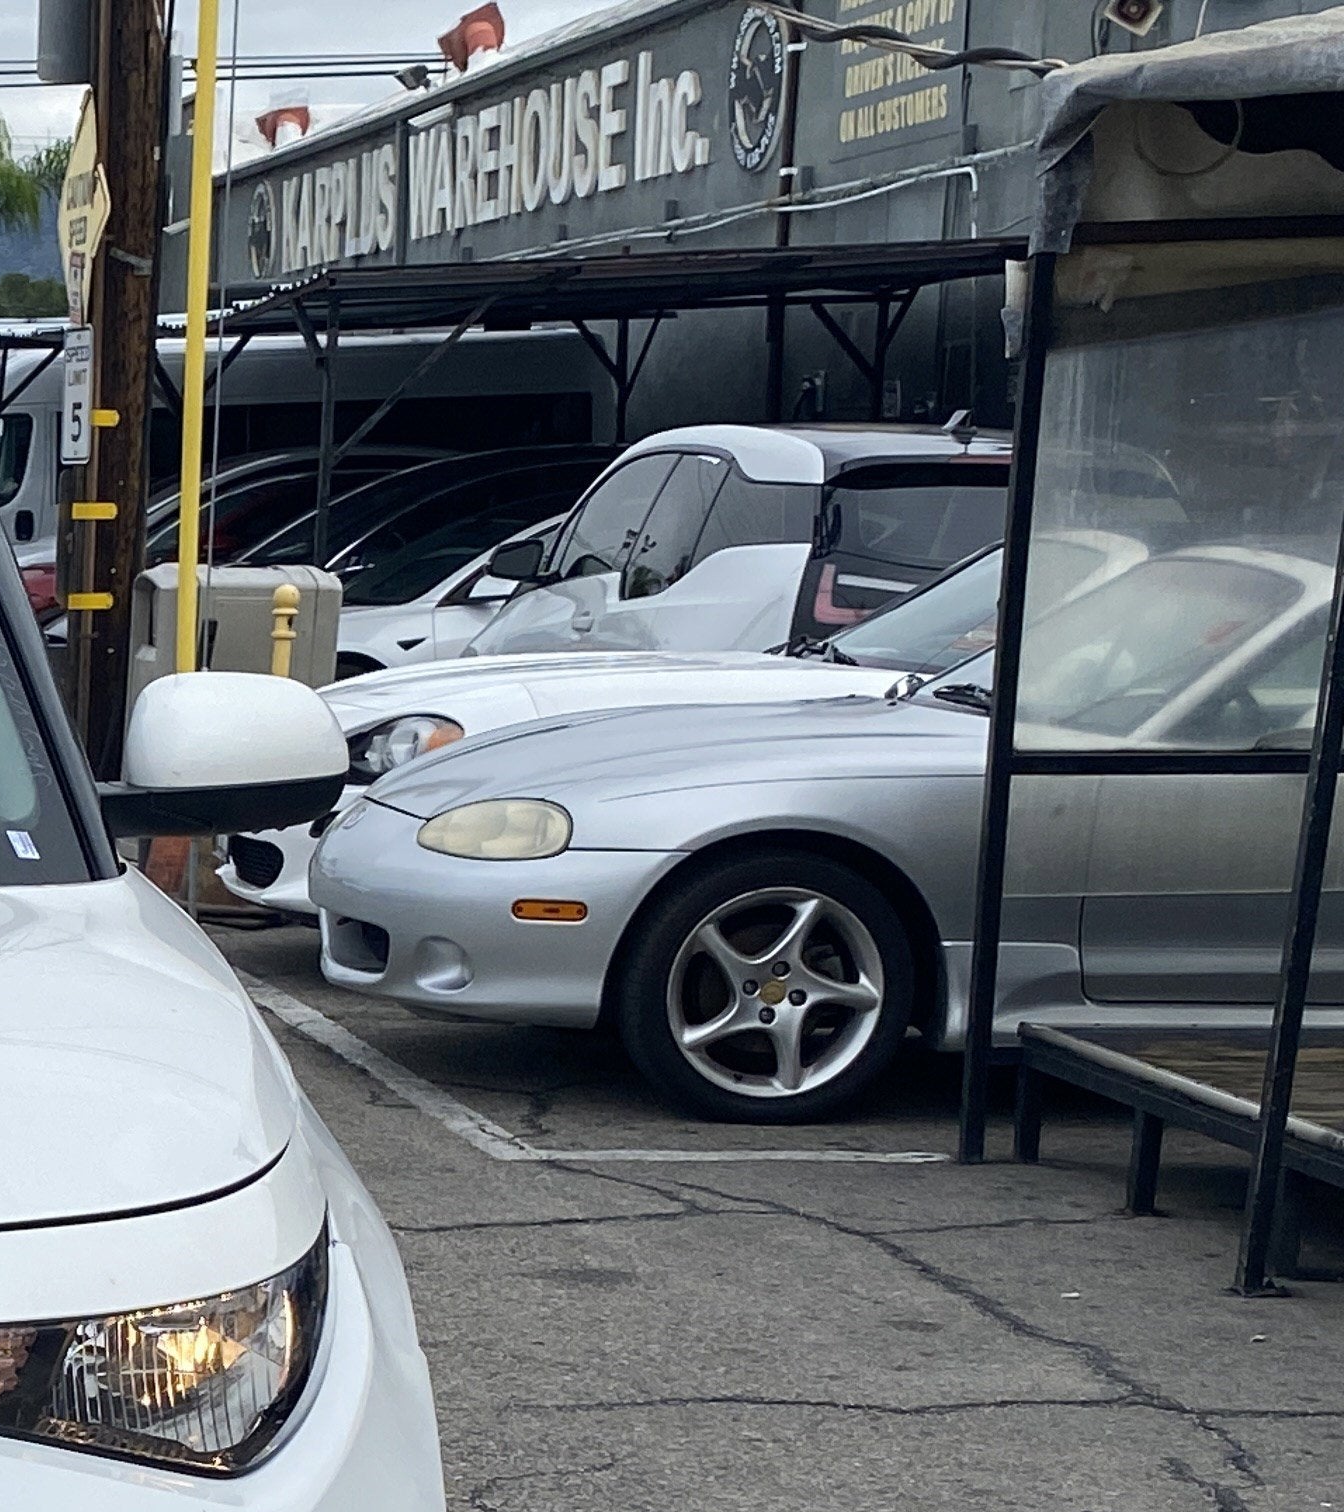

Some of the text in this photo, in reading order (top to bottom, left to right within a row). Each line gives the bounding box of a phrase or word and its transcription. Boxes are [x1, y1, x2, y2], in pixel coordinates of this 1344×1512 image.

[845, 50, 894, 98] DRIVER'S
[840, 83, 948, 143] ON ALL CUSTOMERS
[281, 143, 397, 274] KARPLUS
[409, 59, 630, 242] WAREHOUSE
[634, 50, 710, 182] Inc.
[71, 401, 83, 443] 5
